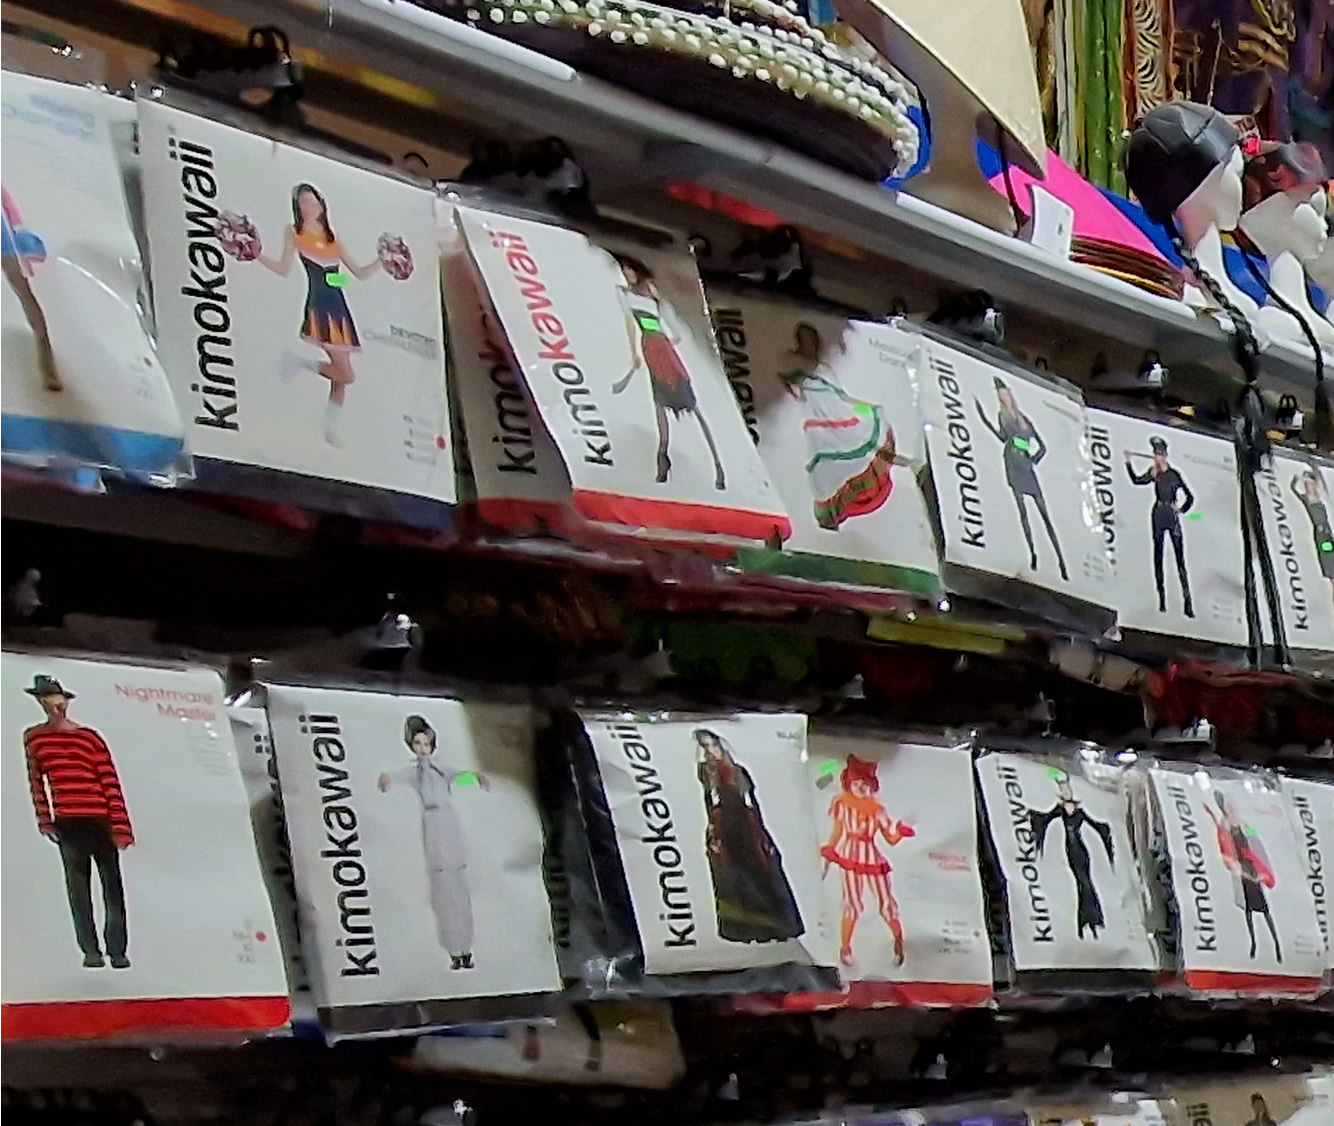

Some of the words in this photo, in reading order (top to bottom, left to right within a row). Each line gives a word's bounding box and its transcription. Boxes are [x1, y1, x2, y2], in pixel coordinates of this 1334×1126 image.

[168, 137, 240, 432] kimokawaii
[485, 229, 614, 468] kimokawaii
[928, 352, 987, 550] kimokawaii
[300, 713, 380, 977] kimokawaii
[605, 724, 698, 949] kimokawaii
[994, 766, 1054, 944] kimokawaii
[1164, 785, 1218, 952] kimokawaii
